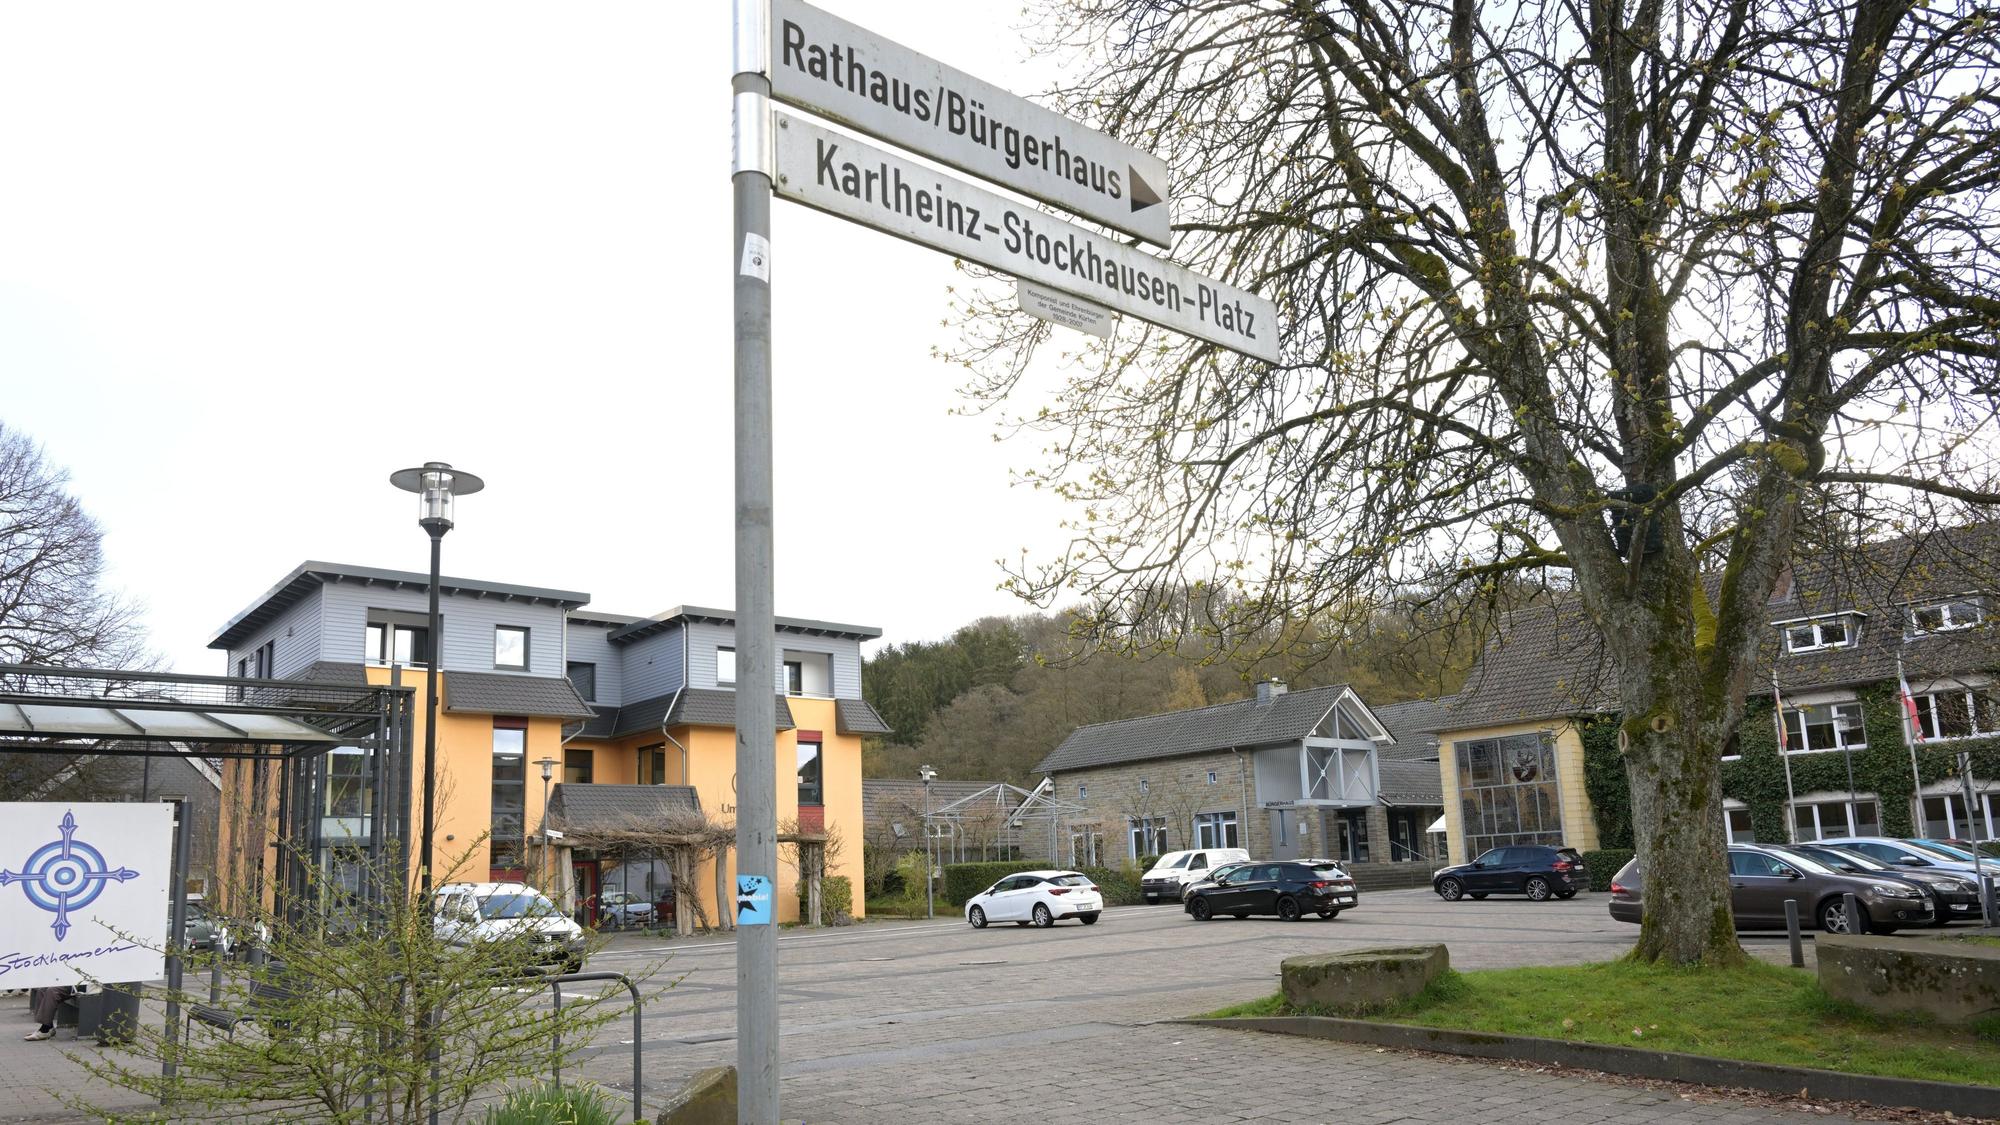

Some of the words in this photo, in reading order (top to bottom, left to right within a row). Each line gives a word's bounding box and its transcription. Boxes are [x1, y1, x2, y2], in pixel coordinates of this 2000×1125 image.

[782, 19, 1123, 200] Rathaus/Bürgerhaus
[816, 138, 1257, 340] Karlheinz-Stockhausen-Platz
[1027, 288, 1058, 304] Komponist
[1059, 300, 1070, 308] und
[1048, 304, 1077, 319] Gemeinde
[0, 944, 138, 976] Stockhausen
